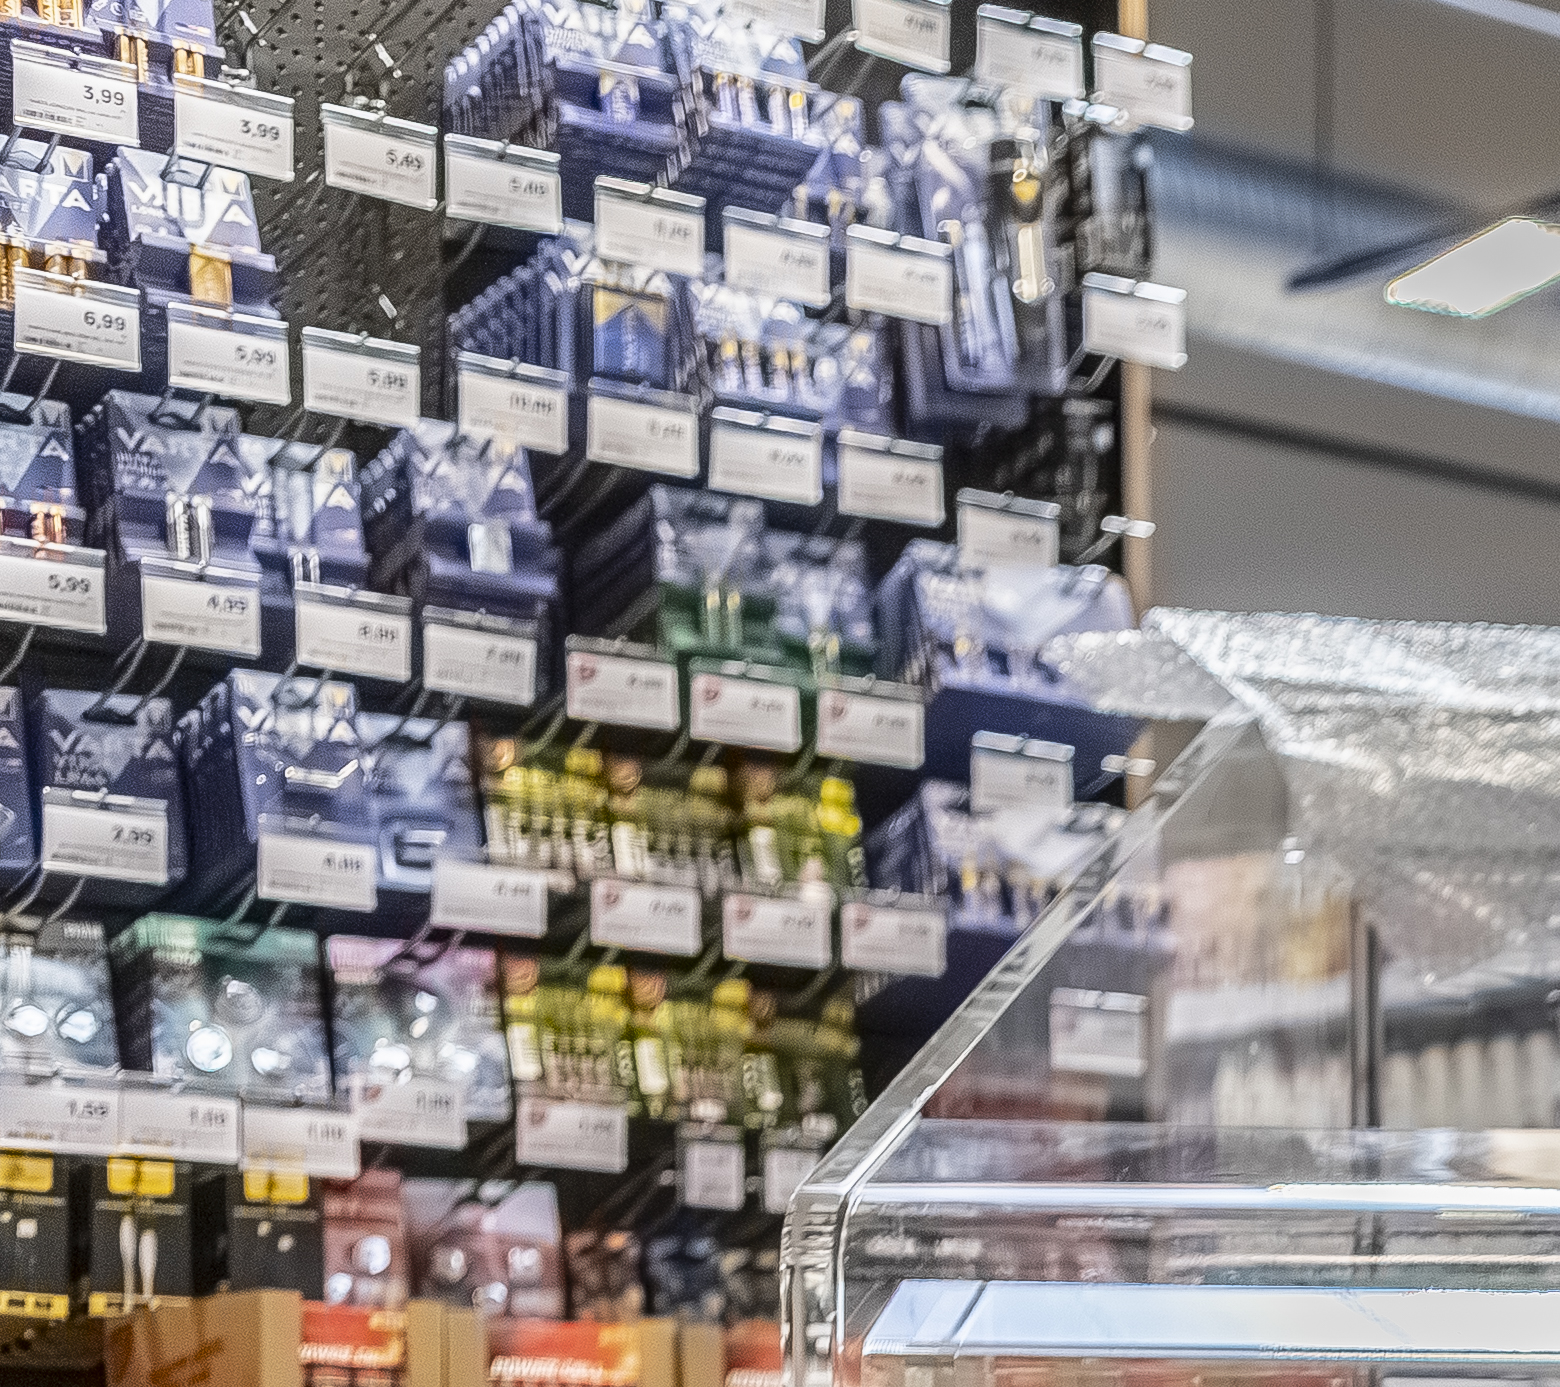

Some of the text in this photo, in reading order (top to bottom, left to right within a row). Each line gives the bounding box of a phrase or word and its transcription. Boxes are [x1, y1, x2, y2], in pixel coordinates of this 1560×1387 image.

[83, 85, 125, 107] 3,99
[239, 119, 281, 142] 3,99
[83, 310, 128, 332] 6,99
